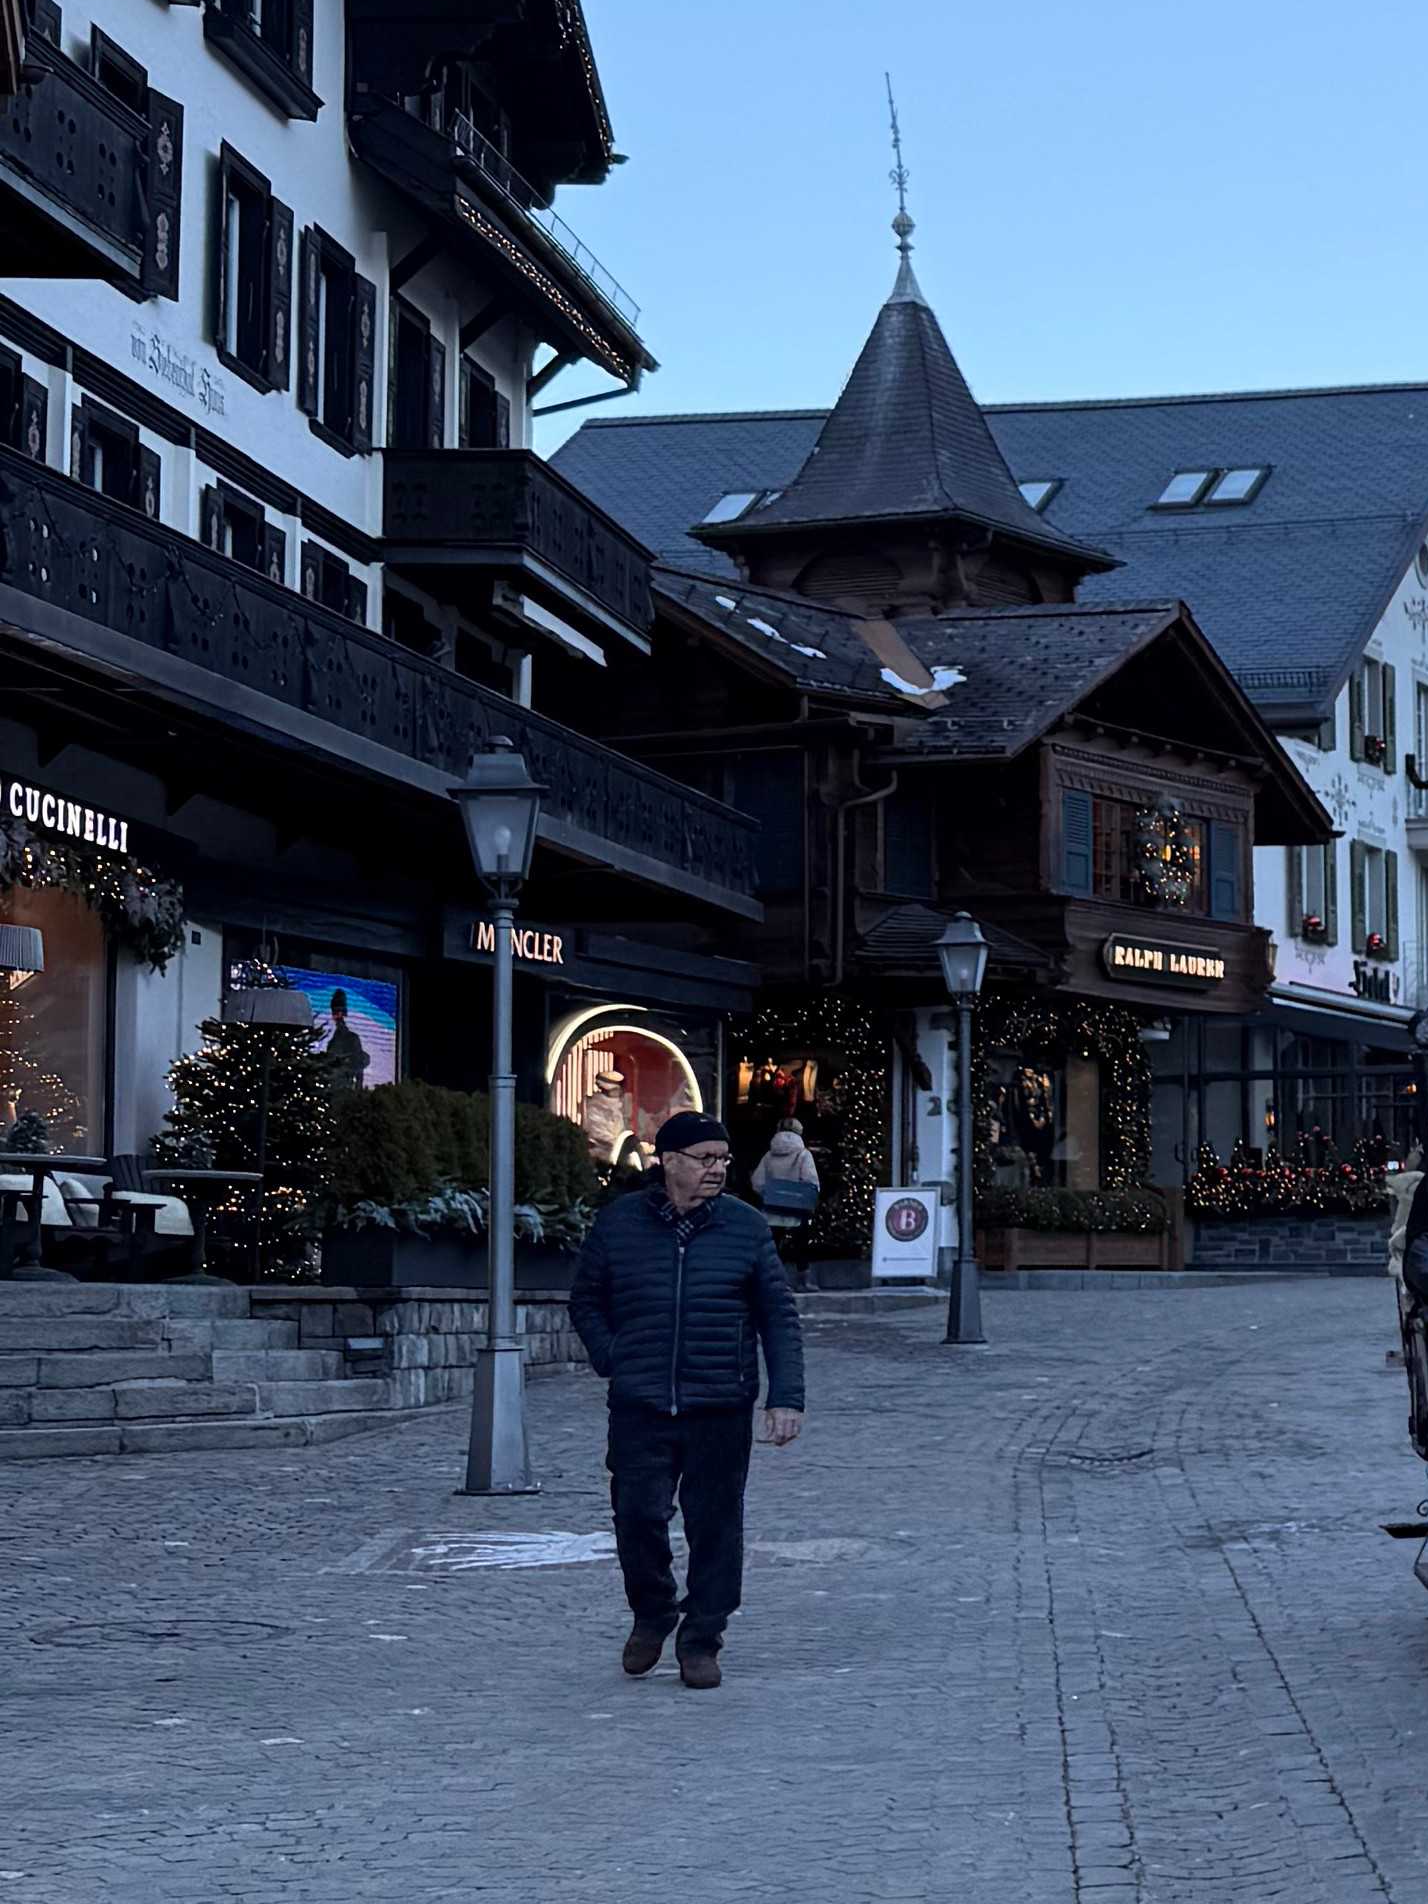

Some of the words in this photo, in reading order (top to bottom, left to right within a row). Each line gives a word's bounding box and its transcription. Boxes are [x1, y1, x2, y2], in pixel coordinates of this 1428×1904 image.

[9, 781, 129, 853] CUCINELLI
[477, 922, 564, 964] MNCLER
[1114, 945, 1163, 971] RALPH
